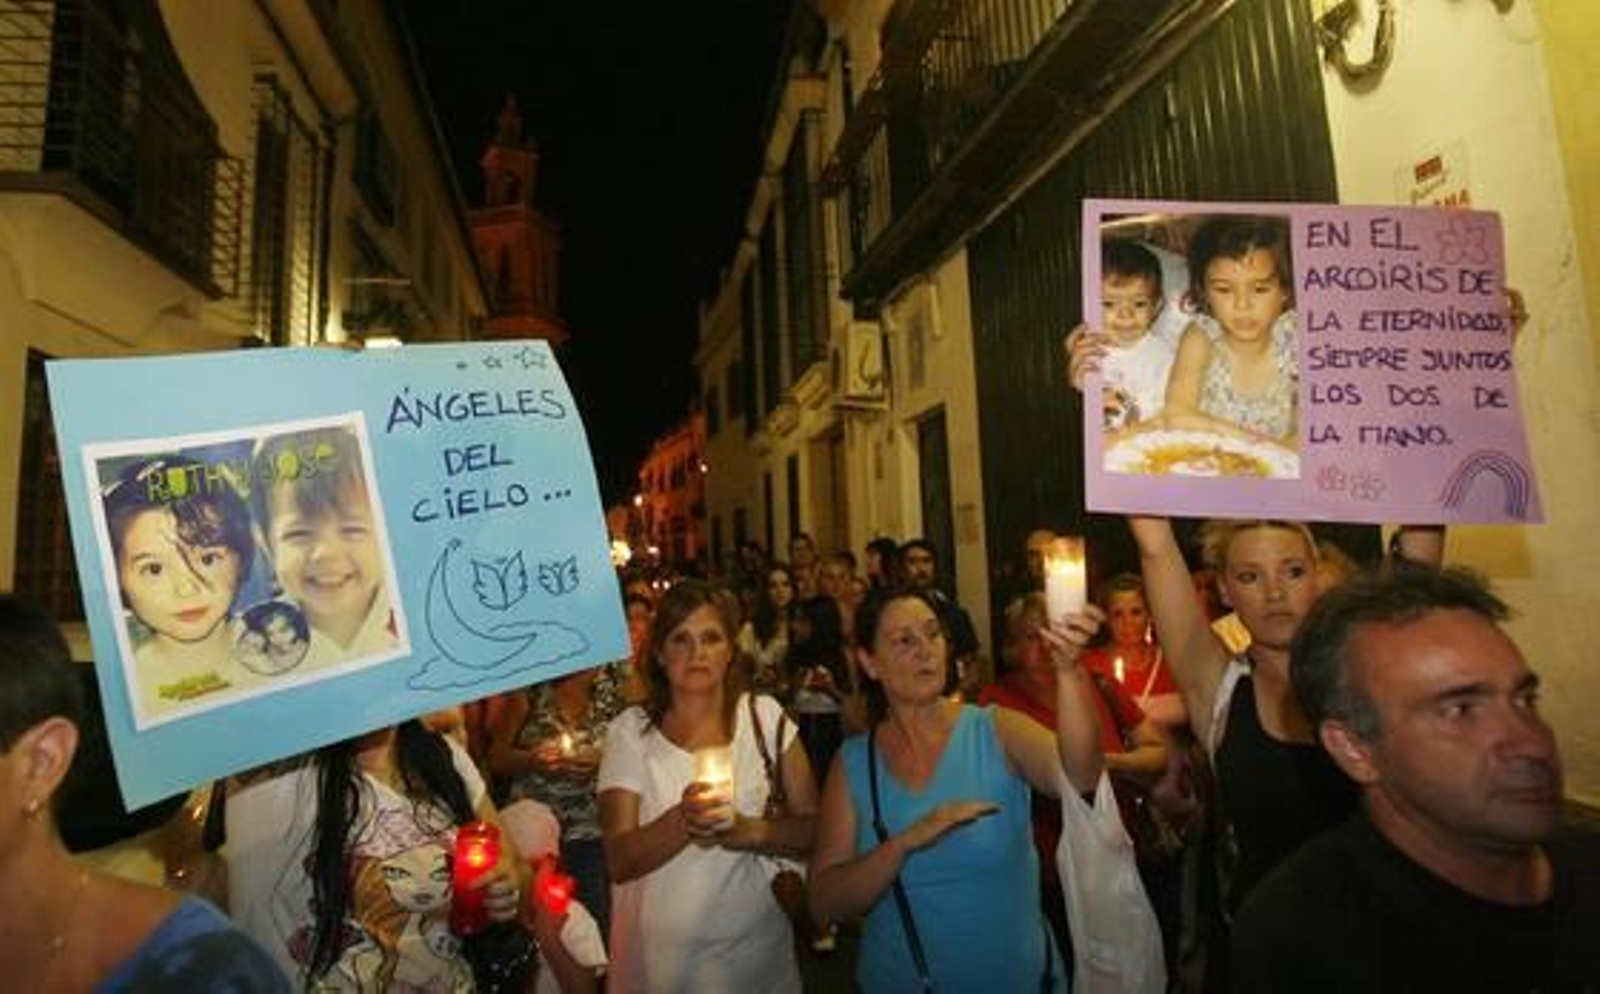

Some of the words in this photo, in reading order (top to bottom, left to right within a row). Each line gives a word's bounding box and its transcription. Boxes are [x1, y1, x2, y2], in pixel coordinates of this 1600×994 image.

[1307, 221, 1351, 249] EN
[1371, 218, 1418, 251] EL
[1458, 269, 1496, 295] DE
[1307, 310, 1342, 332] LA
[1421, 349, 1512, 371] JUNTOS
[1310, 383, 1362, 406] LOS
[1387, 384, 1441, 406] DOS
[1473, 386, 1508, 409] DE
[386, 387, 566, 433] ÁNGELES
[1309, 424, 1341, 444] LA
[1358, 424, 1454, 447] MANO.
[444, 443, 514, 476] DEL
